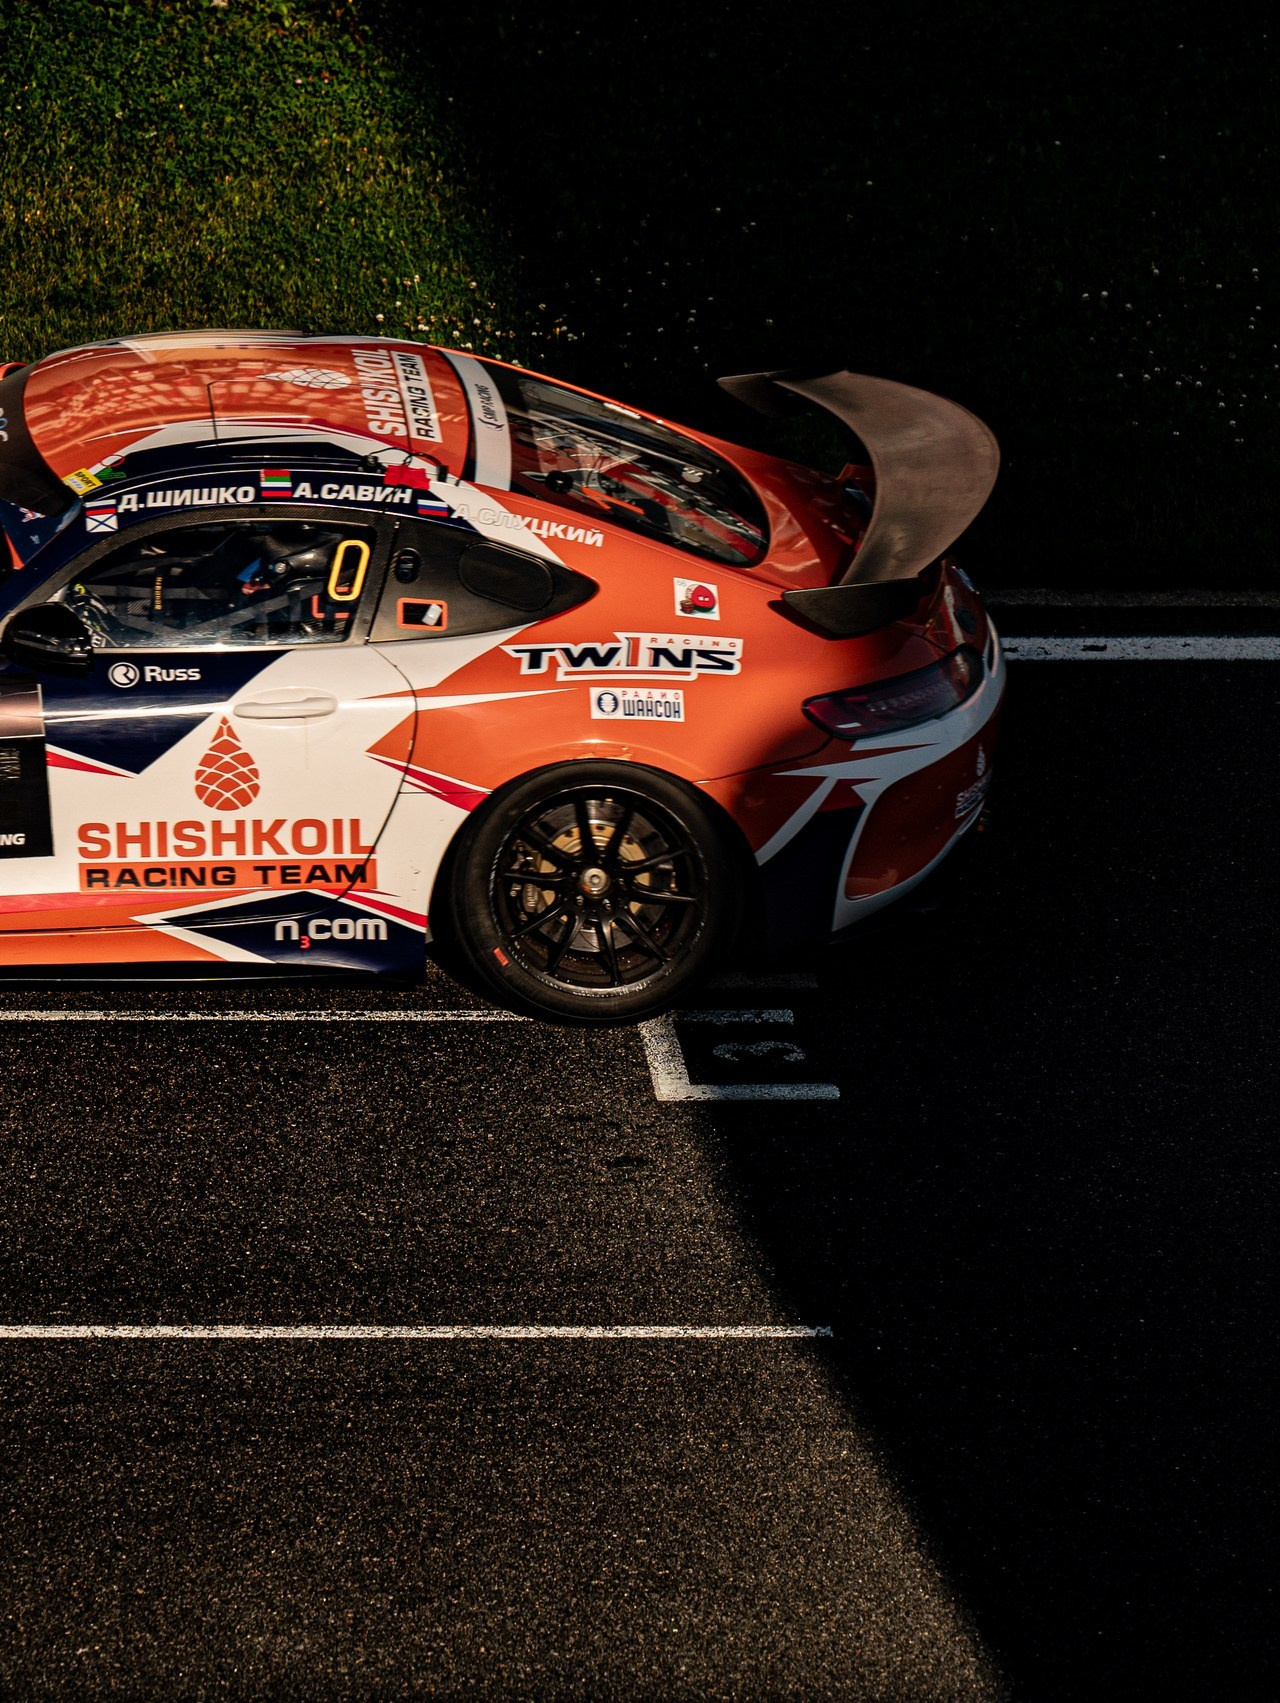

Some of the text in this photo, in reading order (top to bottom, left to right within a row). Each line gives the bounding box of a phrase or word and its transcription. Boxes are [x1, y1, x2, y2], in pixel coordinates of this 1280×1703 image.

[351, 349, 408, 437] SHISHKOIL
[397, 354, 435, 439] RACING TEAM
[74, 471, 96, 488] SPORT
[118, 486, 256, 514] Д.ШИШКО
[292, 482, 413, 505] А.САВИН
[451, 503, 605, 548] А.СЛУЦКИЙ
[512, 636, 736, 670] TWINS
[650, 637, 737, 648] RACING
[621, 690, 680, 701] РАДИО
[622, 700, 681, 719] ШАНСОН
[77, 818, 377, 859] SHISHKOIL
[86, 864, 368, 888] RACING TEAM
